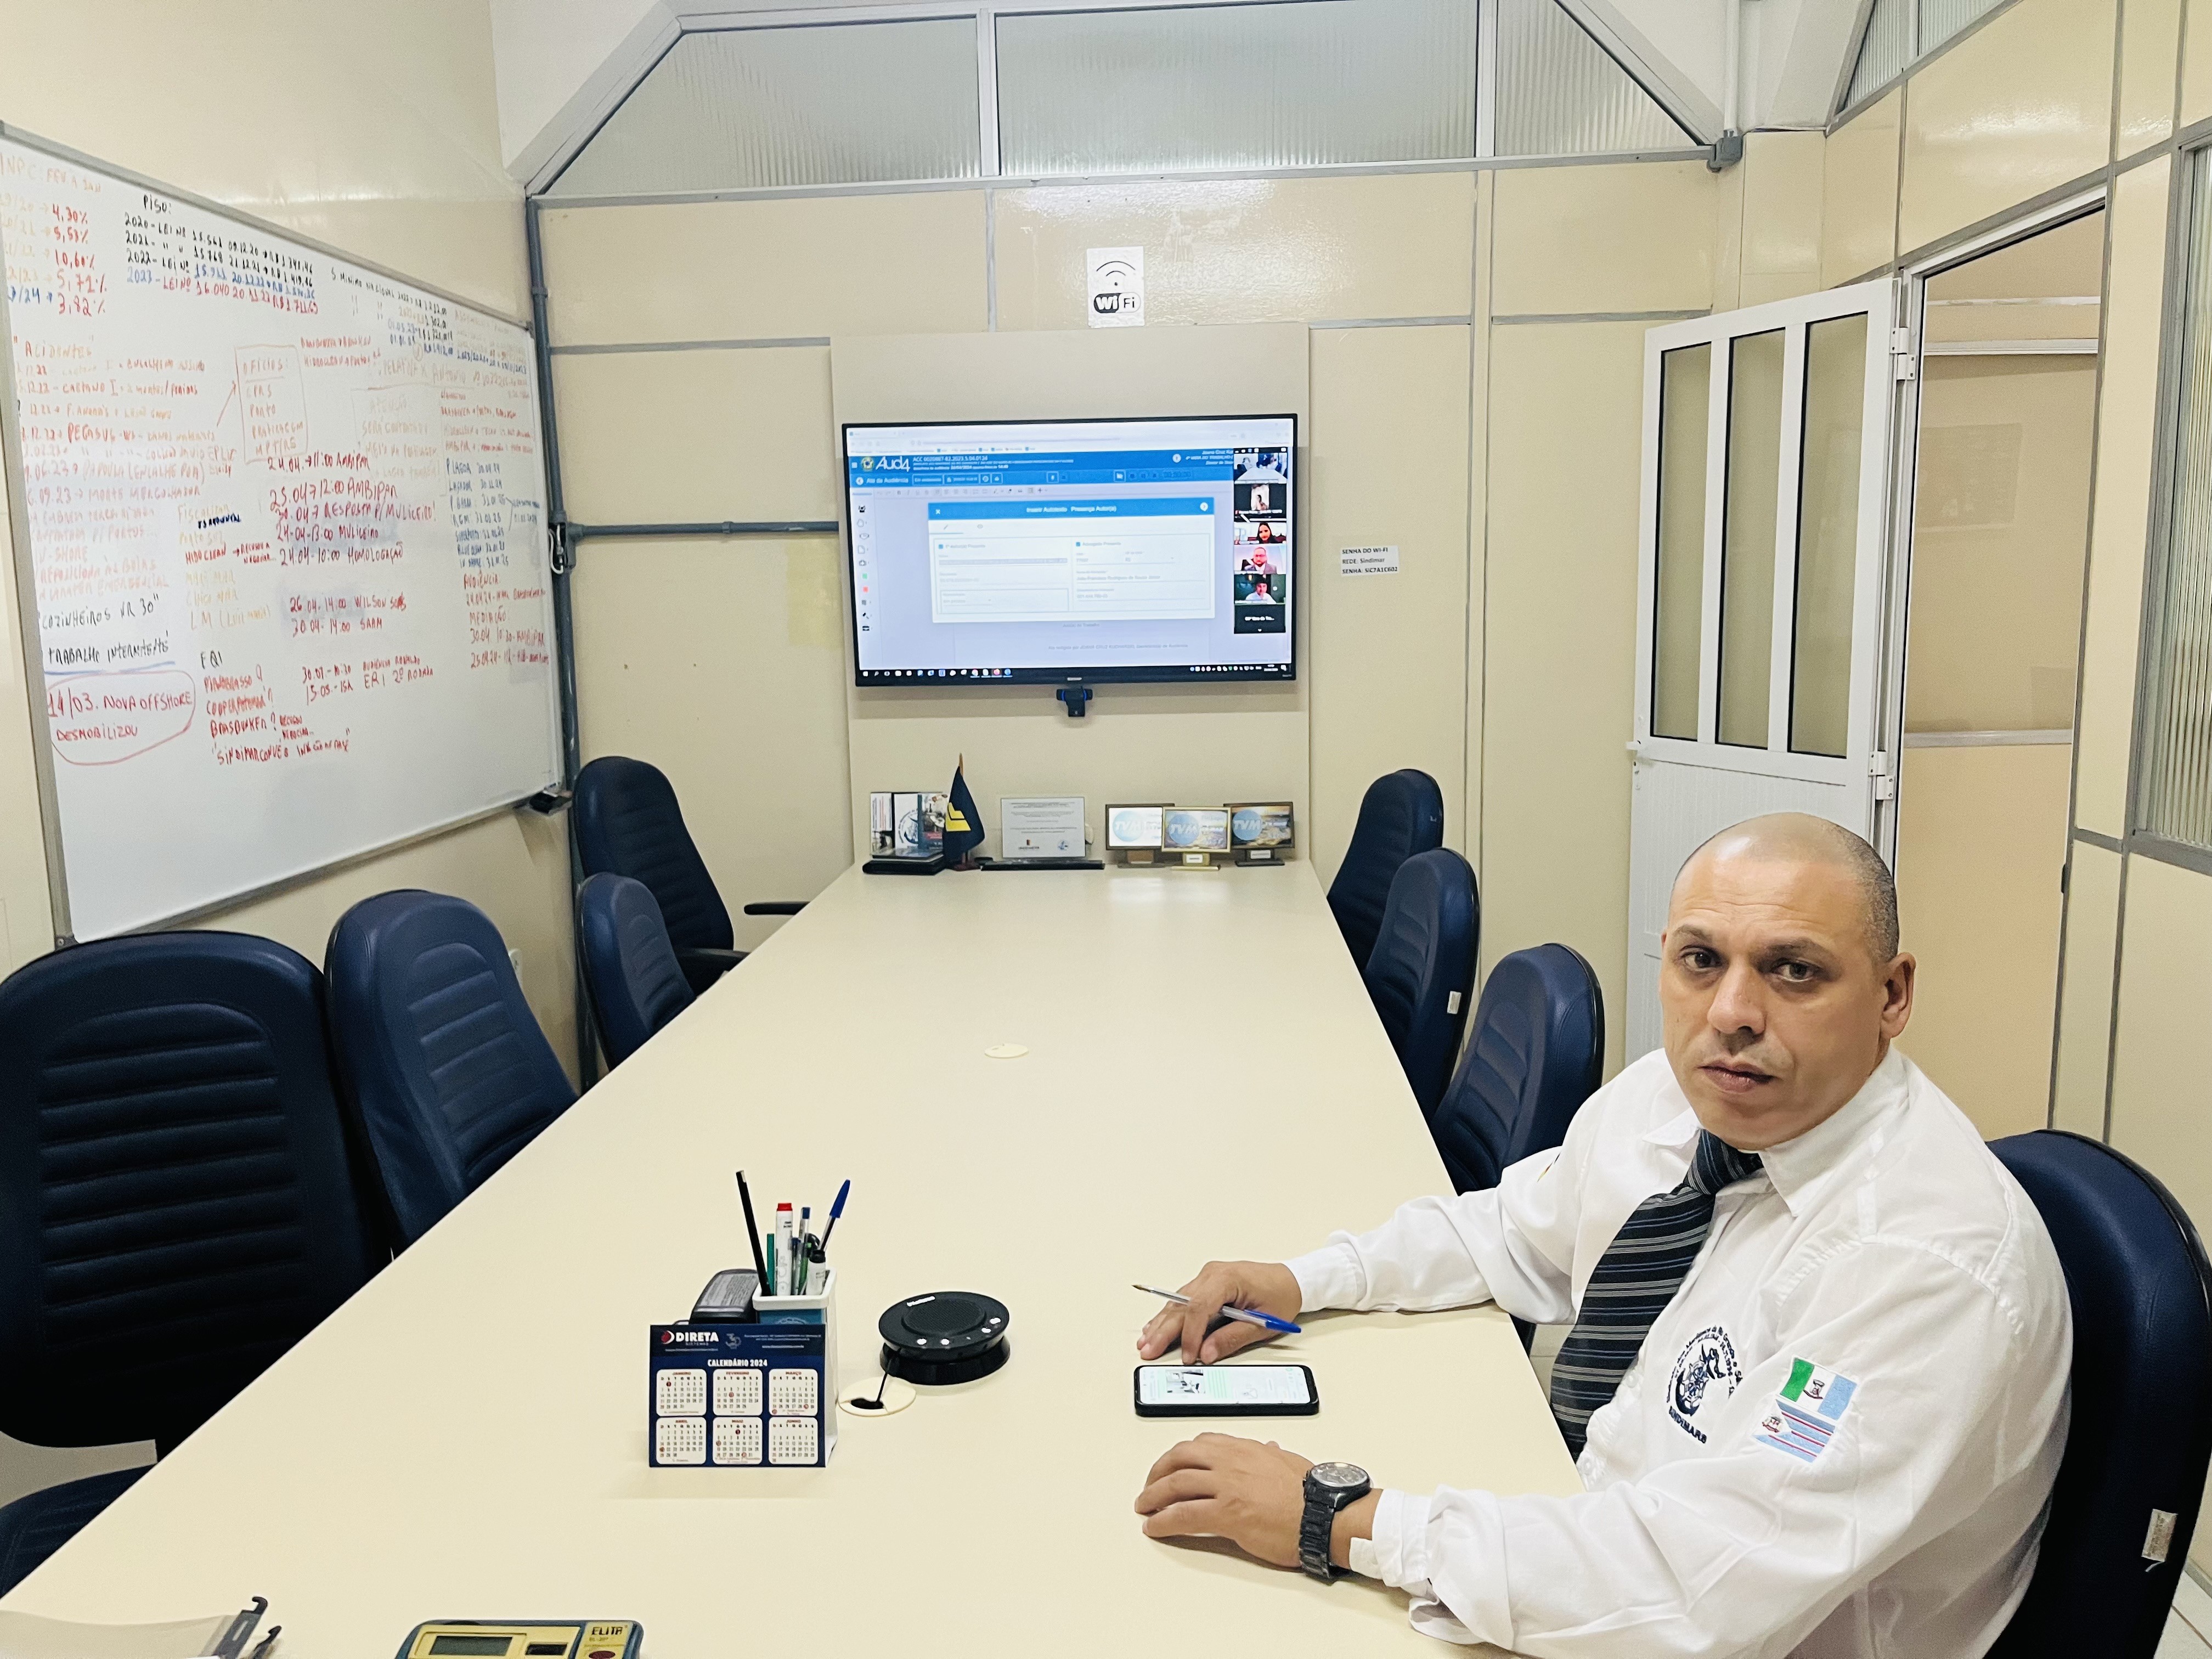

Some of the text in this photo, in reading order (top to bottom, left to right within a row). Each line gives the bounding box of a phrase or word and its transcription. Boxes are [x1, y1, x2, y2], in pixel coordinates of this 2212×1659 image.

[125, 212, 148, 229] 2020
[875, 455, 911, 472] Aud4
[103, 693, 137, 712] NOVA
[139, 690, 193, 712] OFFSHORE
[675, 1331, 719, 1342] DIRETA
[708, 1358, 749, 1367] CALENDÁRIO
